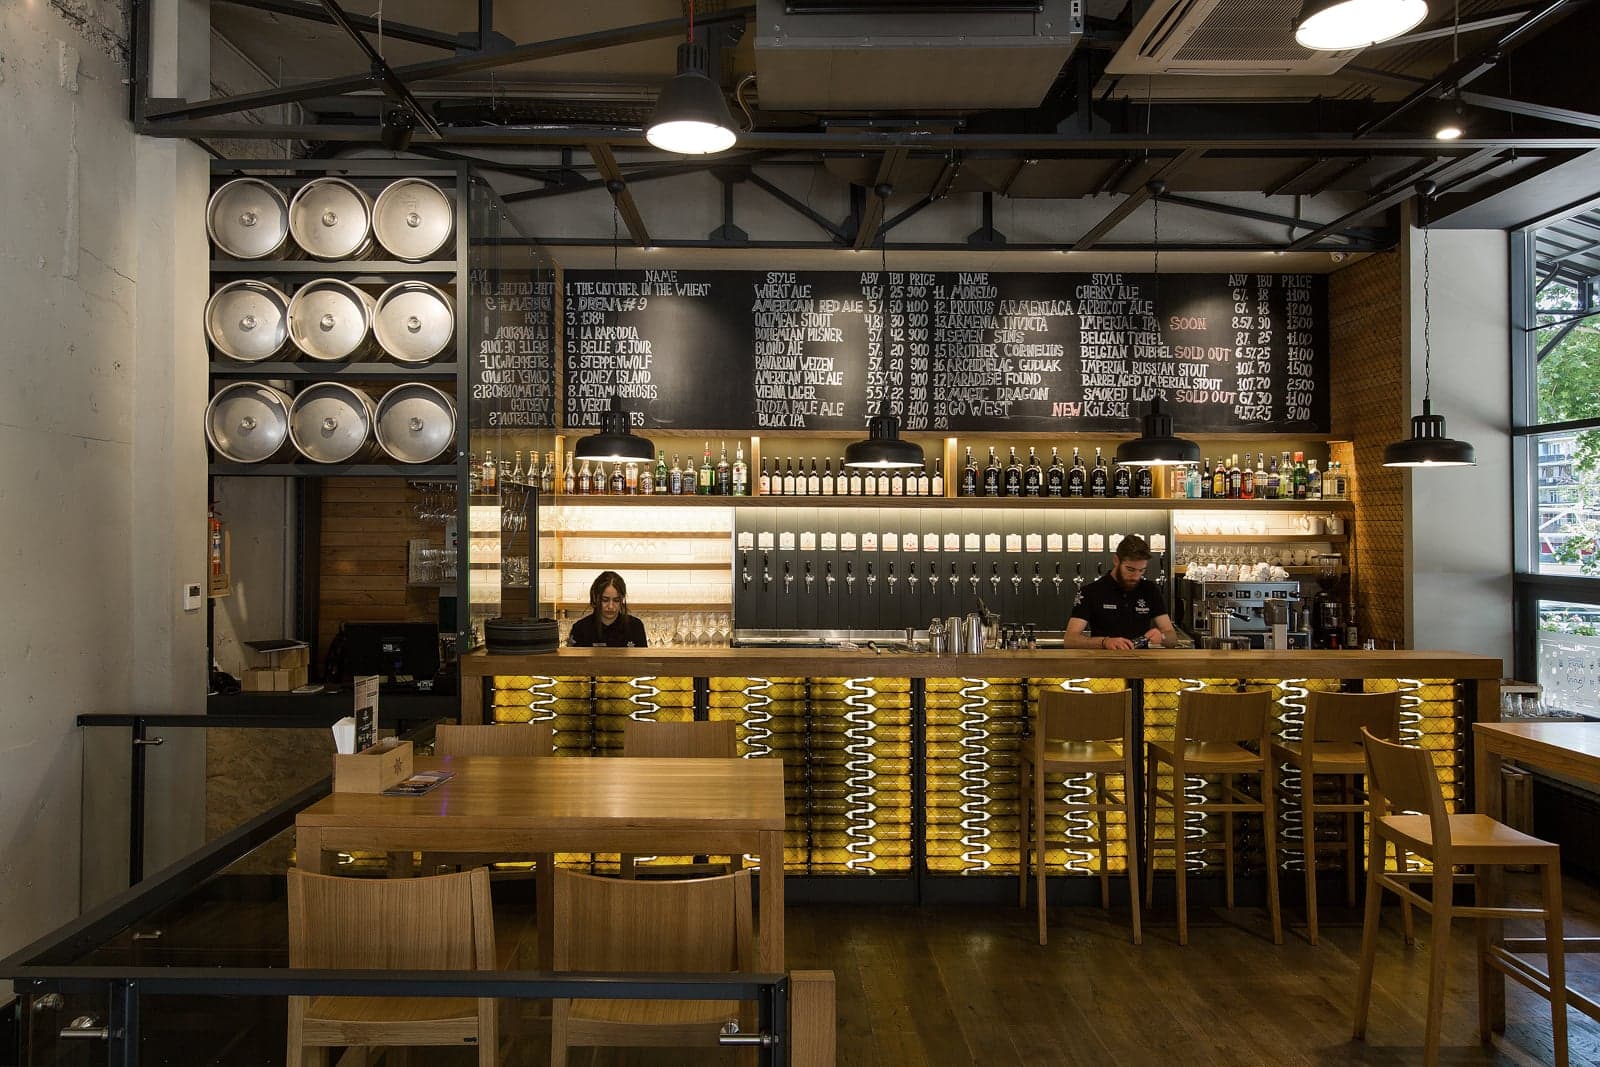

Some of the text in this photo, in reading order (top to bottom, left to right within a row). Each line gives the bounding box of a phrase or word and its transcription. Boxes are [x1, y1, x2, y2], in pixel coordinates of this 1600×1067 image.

[645, 270, 936, 286] NAME STYLE ABV IBU PRICE
[959, 272, 1312, 288] NAME STYLE ABV IBU PRICE
[566, 282, 574, 296] 1.
[574, 282, 595, 296] THE
[596, 282, 639, 296] CATCHER
[641, 282, 652, 296] IN
[654, 282, 673, 296] THE
[674, 283, 711, 296] WHEAT
[754, 284, 791, 298] WHEAT
[791, 285, 812, 298] ALE
[890, 286, 904, 299] 25
[907, 286, 926, 298] 900
[950, 285, 998, 300] MORELLO
[1076, 286, 1116, 300] CHERRY
[1118, 286, 1140, 300] ALE
[566, 297, 576, 310] 2.
[752, 299, 815, 312] AMERICAN
[819, 300, 840, 312] RED
[842, 300, 864, 312] ALE
[889, 300, 903, 314] 50
[950, 300, 995, 314] PRUNUS
[999, 300, 1074, 316] ARMENIACA
[1076, 300, 1126, 315] APRICOT
[1128, 301, 1154, 316] ALE
[566, 312, 928, 328] 3. 1984 OATMEAL STOUT 30 900
[948, 315, 1270, 331] ARMENIA INVICTA IMPERIAL IPA SOON 90
[567, 326, 928, 342] 4. LA RAPSODIA BOHEMIAN PILSNER 42 900
[947, 330, 984, 342] SEVEN
[994, 330, 1025, 344] SINS
[1080, 331, 1125, 345] BELGIAN
[1128, 332, 1164, 345] TRIPEL
[1258, 330, 1272, 344] 25
[568, 341, 930, 356] 5. BELLE DE JOUR BLOND ALE 20 900
[948, 344, 999, 358] BROTHER
[1004, 344, 1064, 357] CORNELIUS
[1080, 345, 1128, 359] BELGIAN
[1174, 346, 1205, 360] SOLD
[1207, 347, 1232, 362] OUT
[1257, 347, 1271, 360] 25
[568, 356, 928, 371] 6. STEPPENWOLF BAVARIAN WEIZEN 20 900
[946, 358, 1014, 372] ARCHIPELAG
[1081, 360, 1129, 374] IMPERIAL
[1132, 361, 1175, 376] RUSSIAN
[1178, 363, 1210, 377] STOUT
[1258, 362, 1270, 374] 70
[569, 370, 928, 386] 7. CONEY ISLAND AMERICAN PALE ALE 40 900
[947, 372, 1002, 387] PARADISE
[1005, 372, 1042, 386] FOUND
[1082, 374, 1116, 387] BARREL
[1118, 374, 1142, 387] AGED
[1144, 376, 1192, 389] IMPERIAL
[1192, 378, 1223, 390] STOUT
[1256, 376, 1270, 390] 70
[1286, 378, 1314, 391] 2500
[568, 385, 926, 400] 8. VIENNA LAGER 22 900
[948, 388, 990, 400] MAGIC
[996, 387, 1050, 400] DRAGON
[1084, 388, 1128, 401] SMOKED
[1176, 390, 1209, 404] SOLD
[1211, 391, 1238, 404] OUT
[1256, 392, 1272, 404] 30
[1286, 392, 1312, 406] 1100
[568, 398, 578, 411] 9.
[756, 400, 789, 414] INDIA
[792, 401, 818, 415] PALE
[820, 402, 844, 416] ALE
[890, 401, 904, 415] 50
[948, 401, 966, 416] GO
[968, 400, 1013, 416] WEST
[1050, 402, 1082, 417] NEW
[1256, 405, 1272, 420] 25
[1286, 406, 1310, 420] 900
[568, 413, 580, 426] 10.
[758, 413, 787, 426] BLACK
[790, 414, 806, 427] IPA
